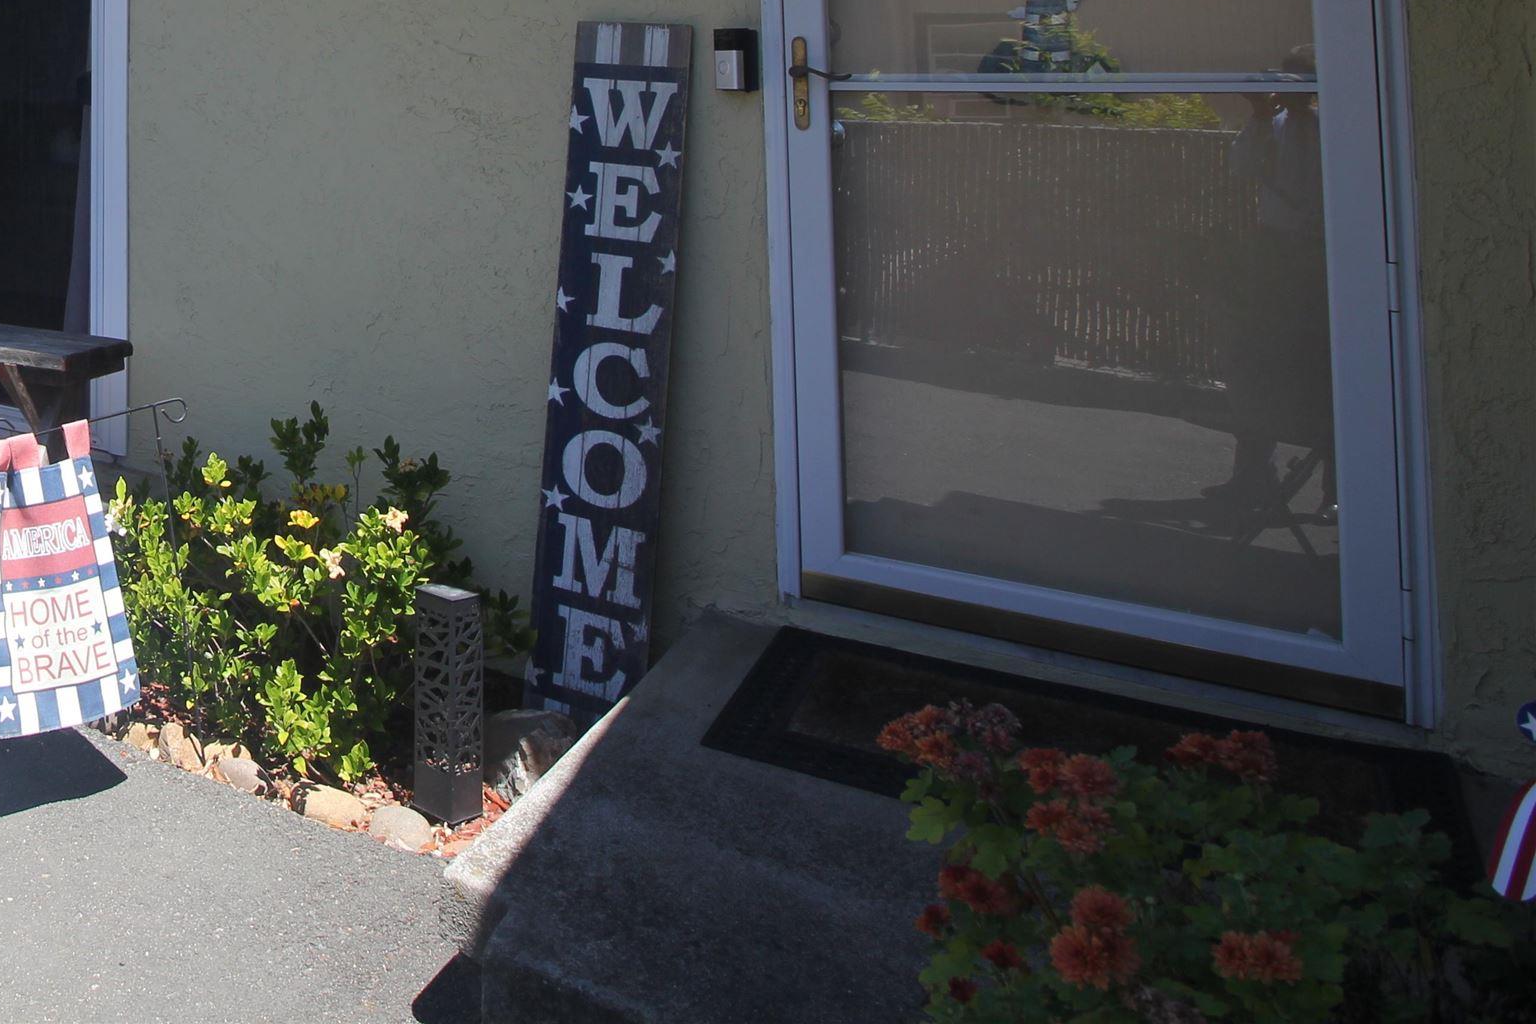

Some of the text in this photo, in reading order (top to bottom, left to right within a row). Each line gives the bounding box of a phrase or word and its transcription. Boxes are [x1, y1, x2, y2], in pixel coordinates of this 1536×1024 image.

[552, 77, 677, 698] WELCOME
[2, 516, 90, 560] AMERICA
[11, 590, 93, 628] HOME
[32, 626, 88, 650] of the
[18, 641, 111, 685] BRAVE
